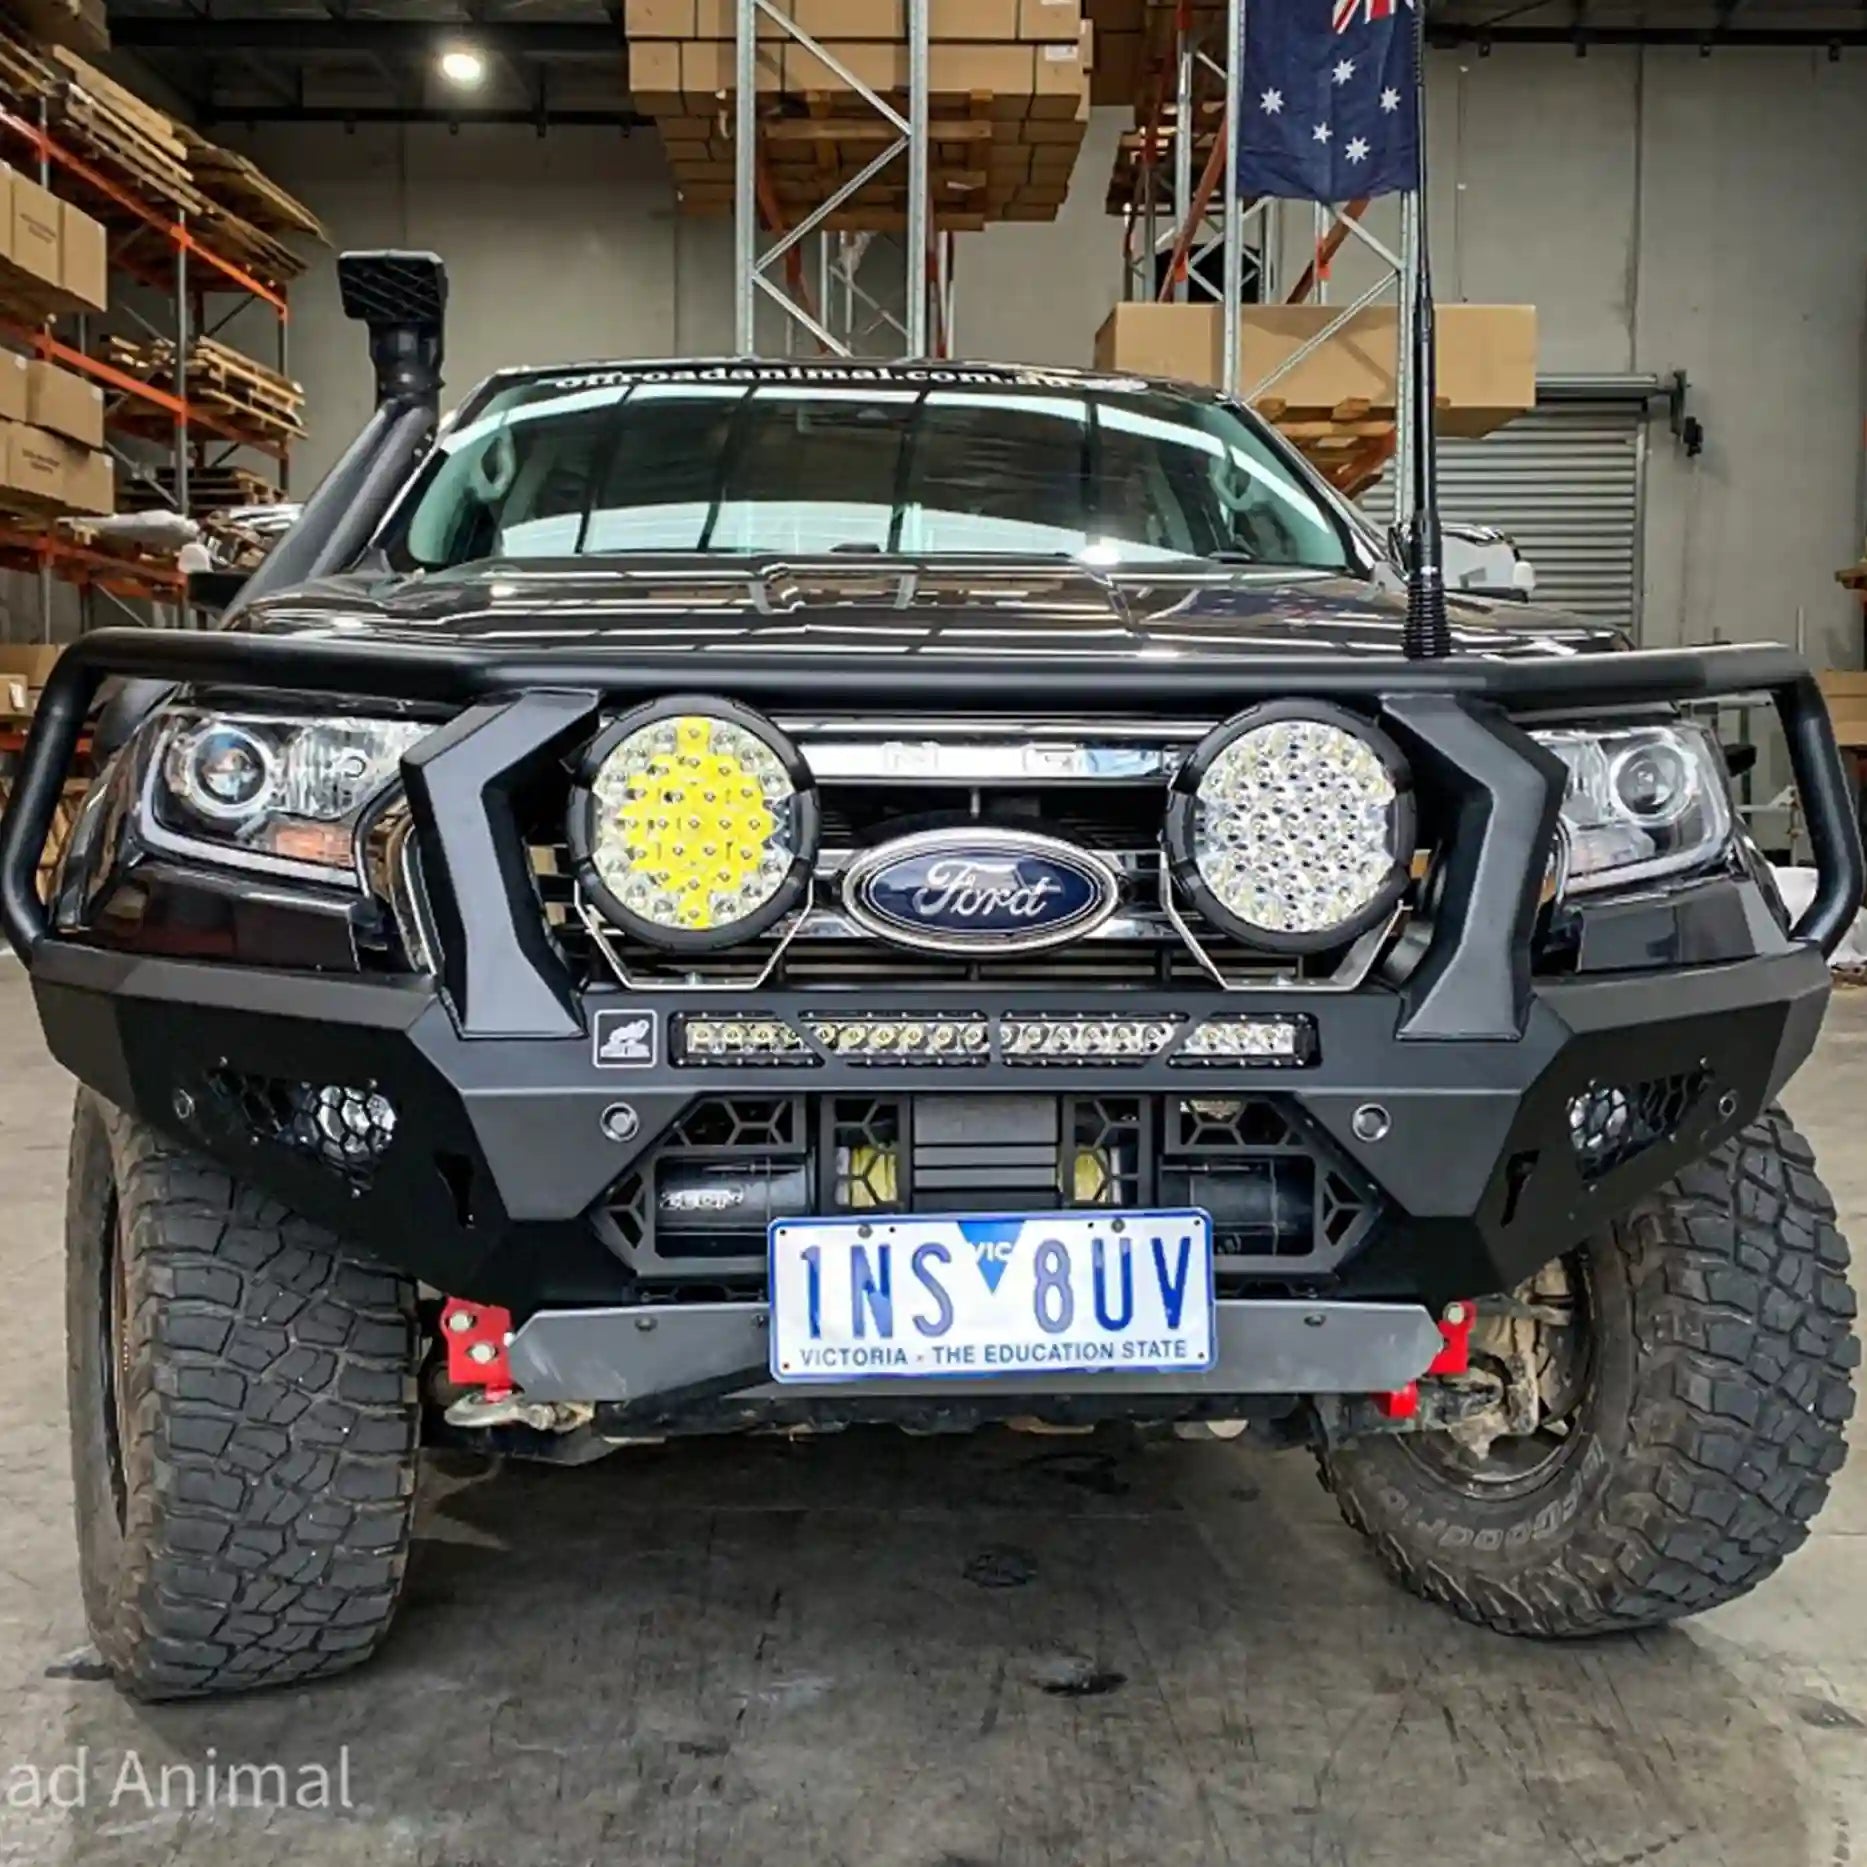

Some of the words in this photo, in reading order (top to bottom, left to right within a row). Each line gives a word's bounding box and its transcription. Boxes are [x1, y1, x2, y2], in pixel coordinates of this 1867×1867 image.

[912, 860, 1062, 917] Ford
[971, 1242, 1012, 1263] VIC
[800, 1241, 955, 1340] 1NS
[1032, 1235, 1192, 1335] 8UV
[800, 1346, 908, 1367] VICTORIA
[932, 1344, 975, 1364] THE
[983, 1341, 1114, 1364] EDUCATION
[1121, 1338, 1188, 1361] STATE
